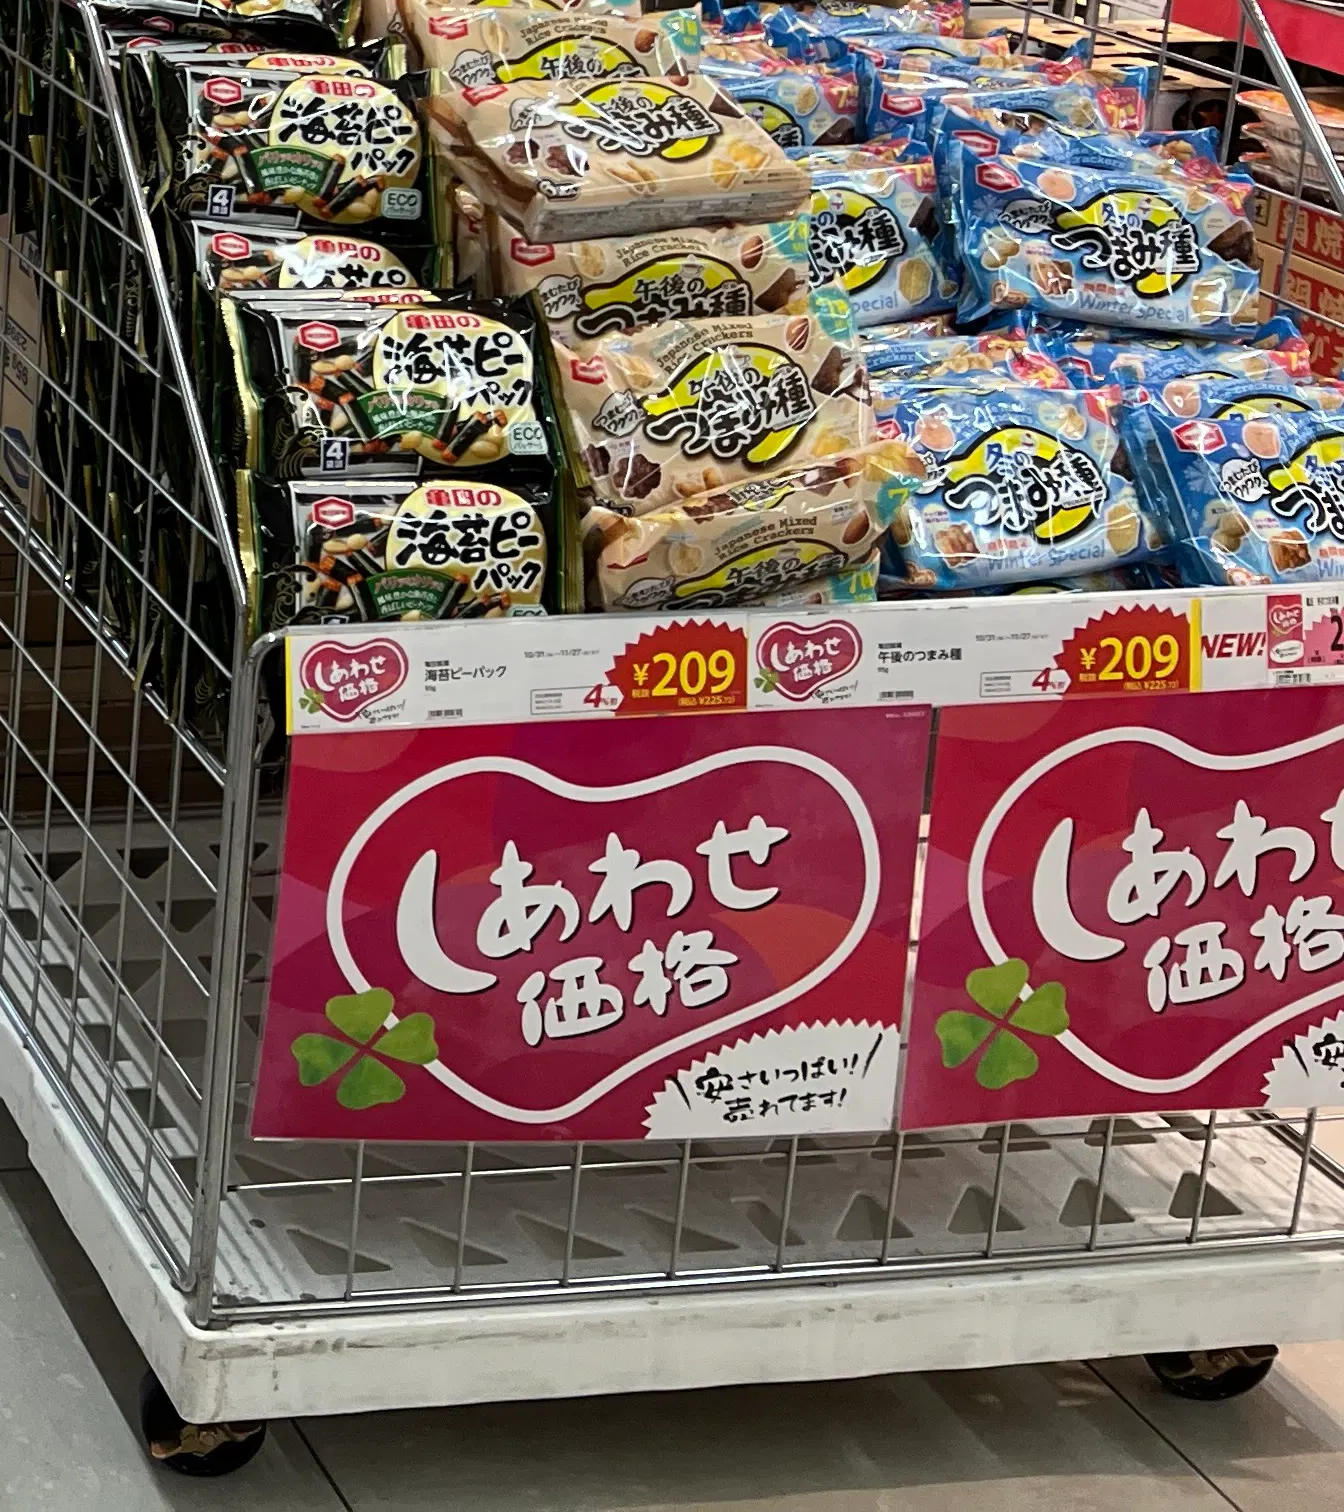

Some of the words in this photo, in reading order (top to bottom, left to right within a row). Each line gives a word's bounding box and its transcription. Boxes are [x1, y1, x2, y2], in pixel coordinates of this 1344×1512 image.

[308, 80, 375, 97] 亀田の
[387, 193, 417, 206] ECO
[1052, 221, 1200, 282] つまみ種
[633, 277, 705, 303] 午後の
[1079, 292, 1133, 313] Winter
[405, 314, 481, 330] 亀田の
[689, 367, 761, 399] 午後の
[513, 424, 542, 440] ECO
[425, 489, 501, 508] 亀田の
[727, 556, 800, 584] 午後の
[988, 551, 1039, 571] Winter
[1049, 546, 1106, 567] Special
[771, 637, 841, 669] しあわせ
[877, 648, 962, 663] 午後のつまみ種
[314, 653, 387, 686] しあわせ
[424, 666, 507, 682] 海苔ピーパック
[791, 658, 834, 683] 価格
[338, 677, 380, 702] 価格
[397, 815, 791, 996] しあわせ
[516, 930, 738, 1046] 価格
[722, 1094, 849, 1124] 売れてます!
